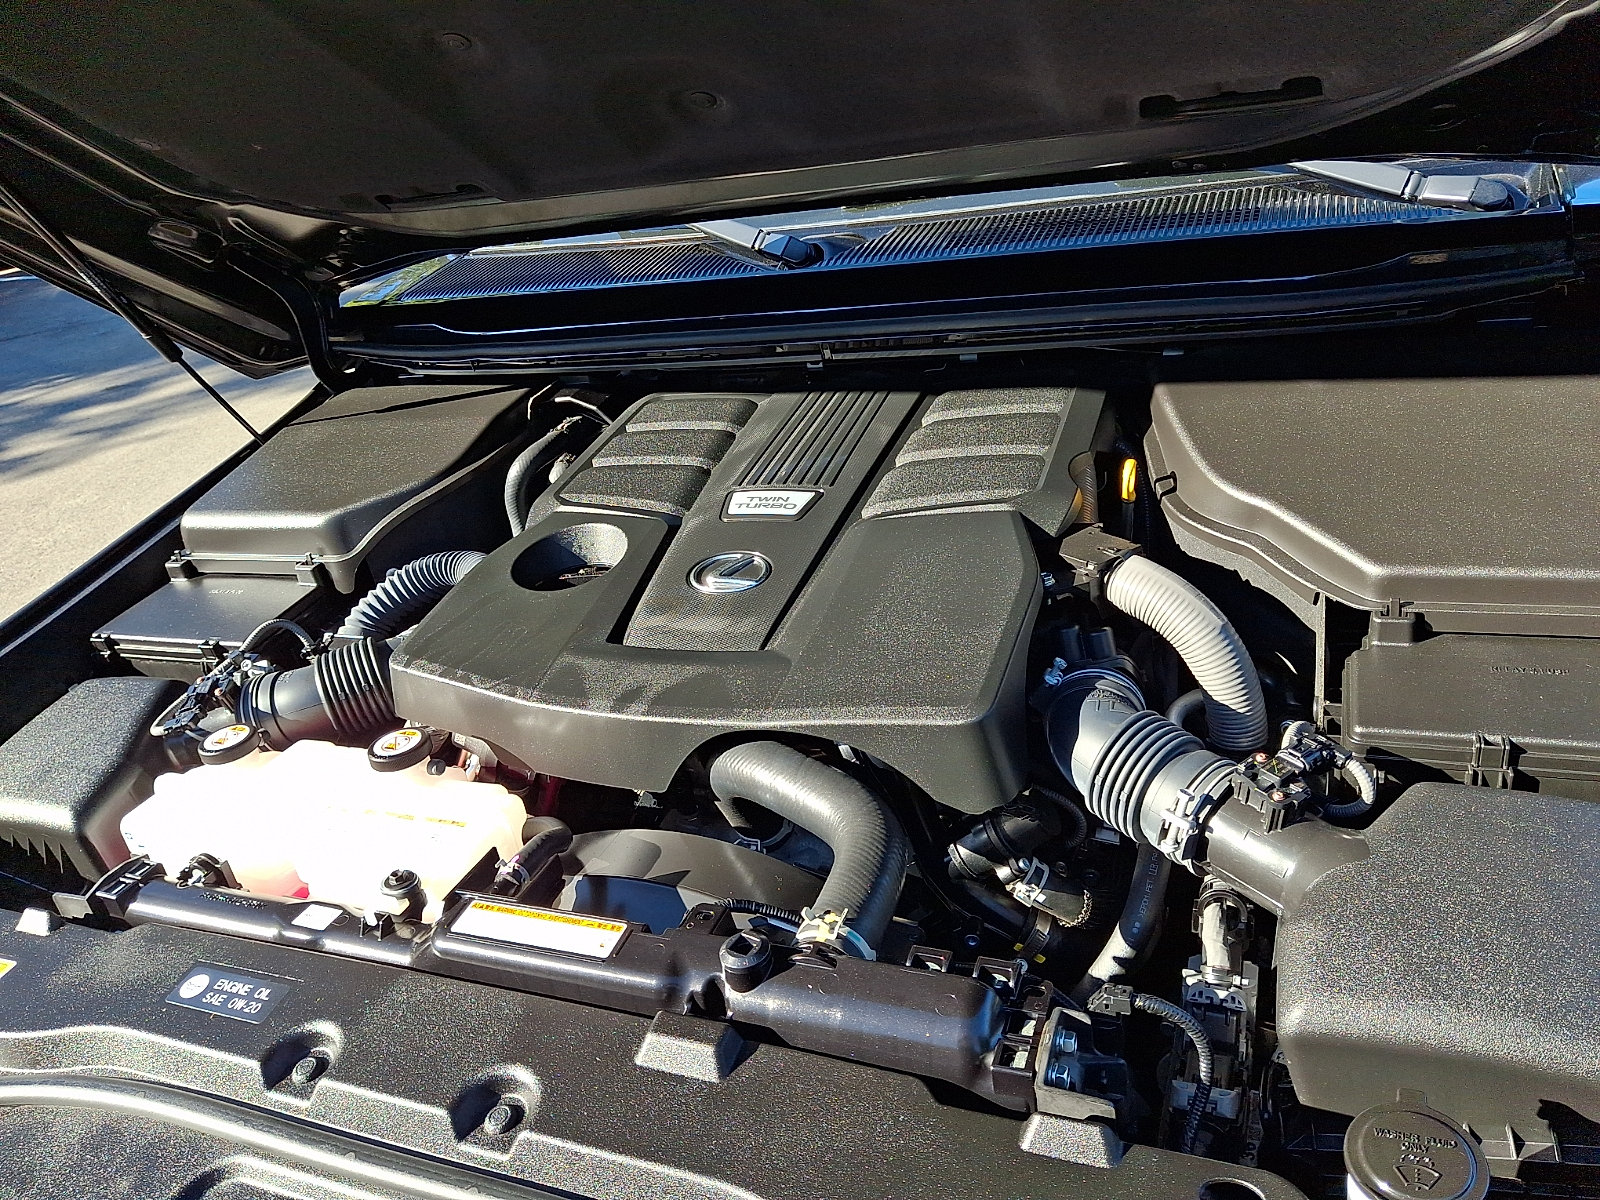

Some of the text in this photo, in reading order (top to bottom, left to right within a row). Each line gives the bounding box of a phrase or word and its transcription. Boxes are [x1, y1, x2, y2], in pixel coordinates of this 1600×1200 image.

[213, 979, 254, 996] ENGINE
[254, 988, 272, 1001] OIL
[202, 992, 262, 1014] SAE 0W-20
[1373, 1127, 1459, 1149] WASHER FLUID
[1400, 1142, 1430, 1154] ONLY
